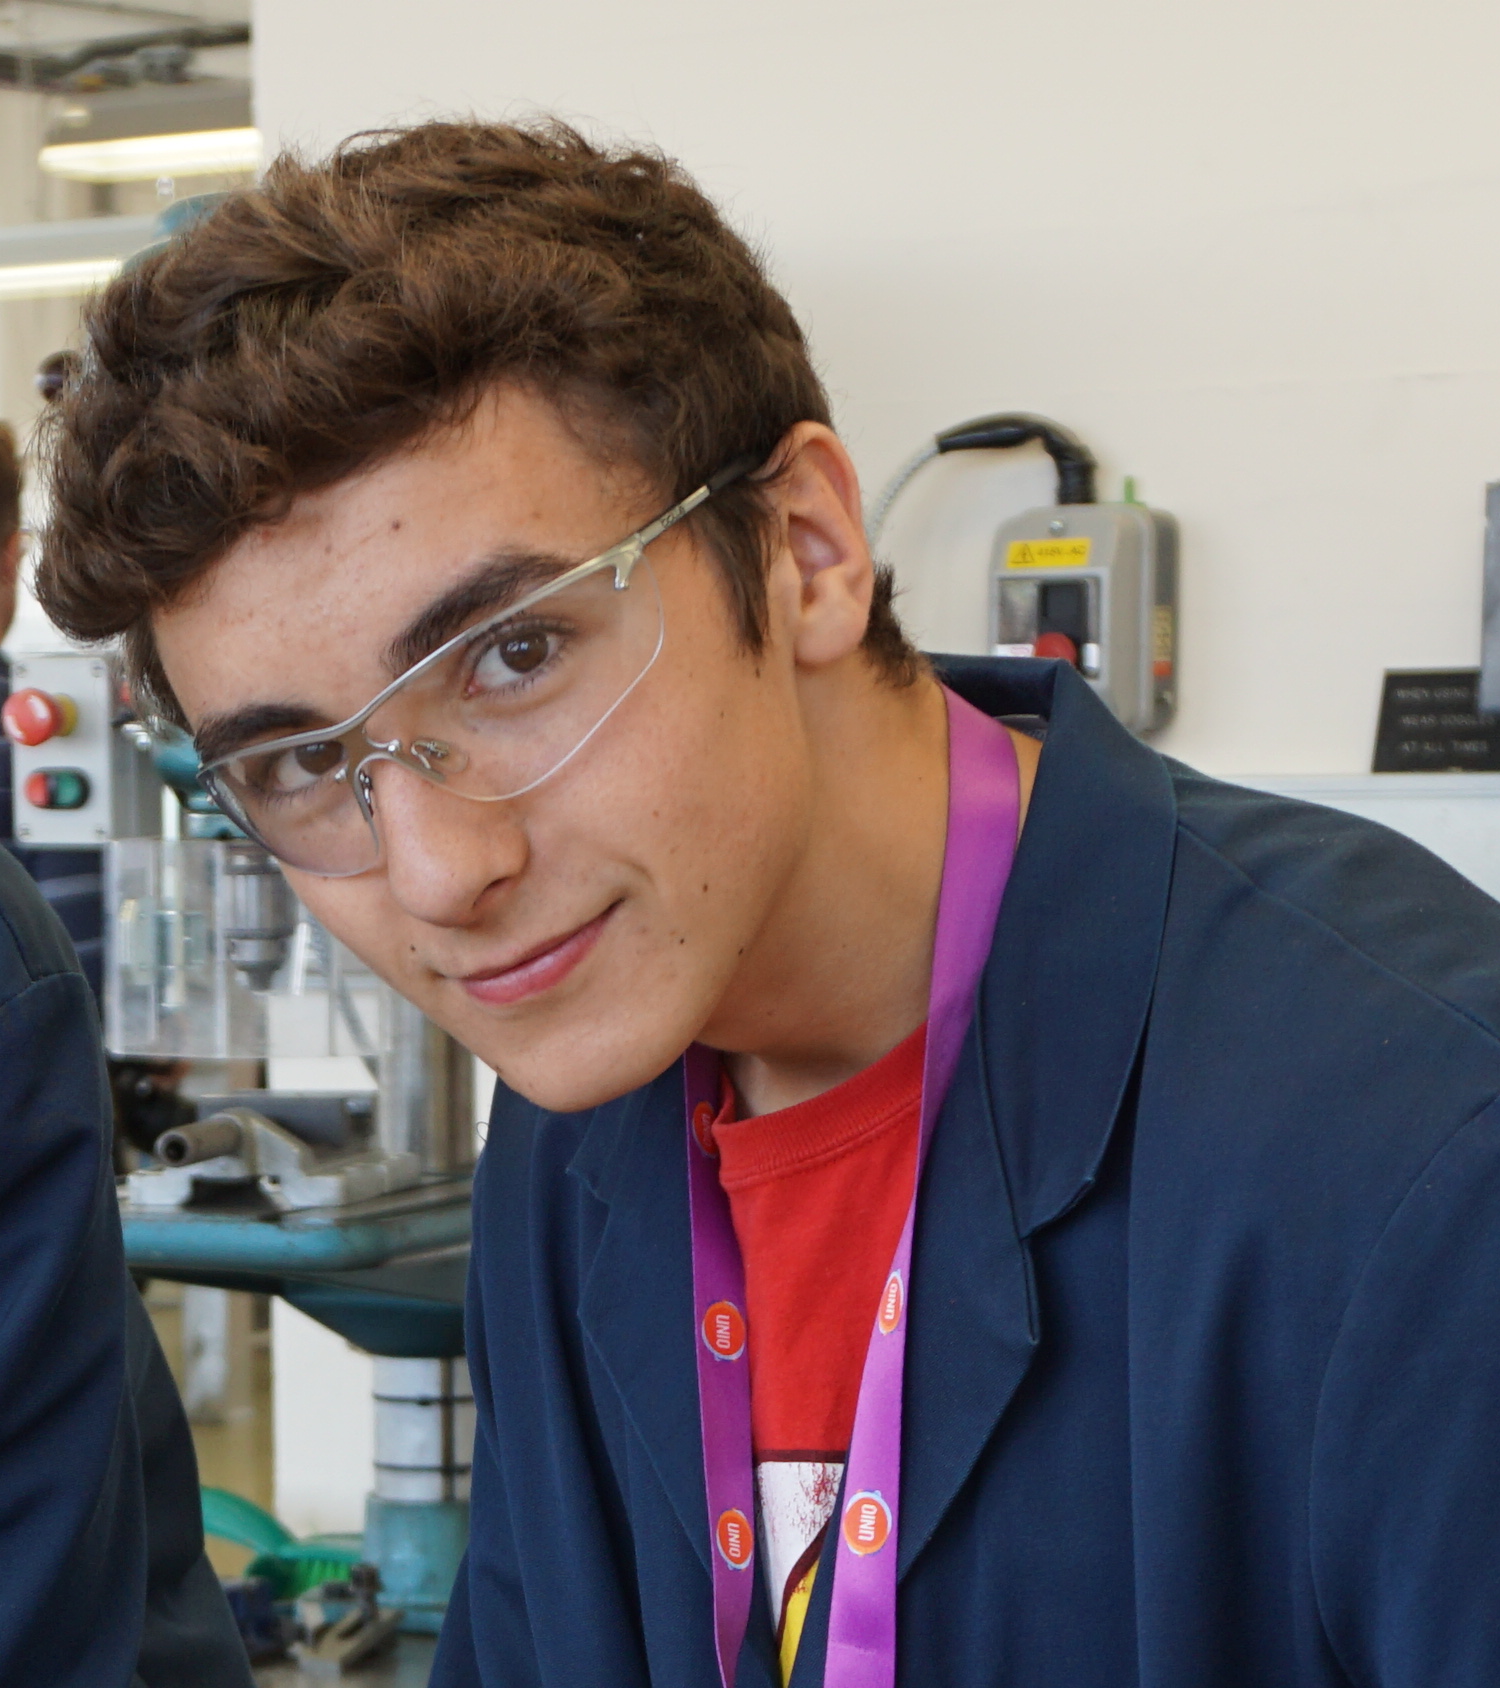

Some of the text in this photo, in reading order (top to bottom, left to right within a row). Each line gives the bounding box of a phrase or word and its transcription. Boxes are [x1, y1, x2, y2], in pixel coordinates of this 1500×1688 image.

[885, 1283, 898, 1320] UNIQ
[715, 1314, 730, 1349] UNIQ
[729, 1522, 741, 1558] UNIQ
[859, 1504, 878, 1541] UNIQ
